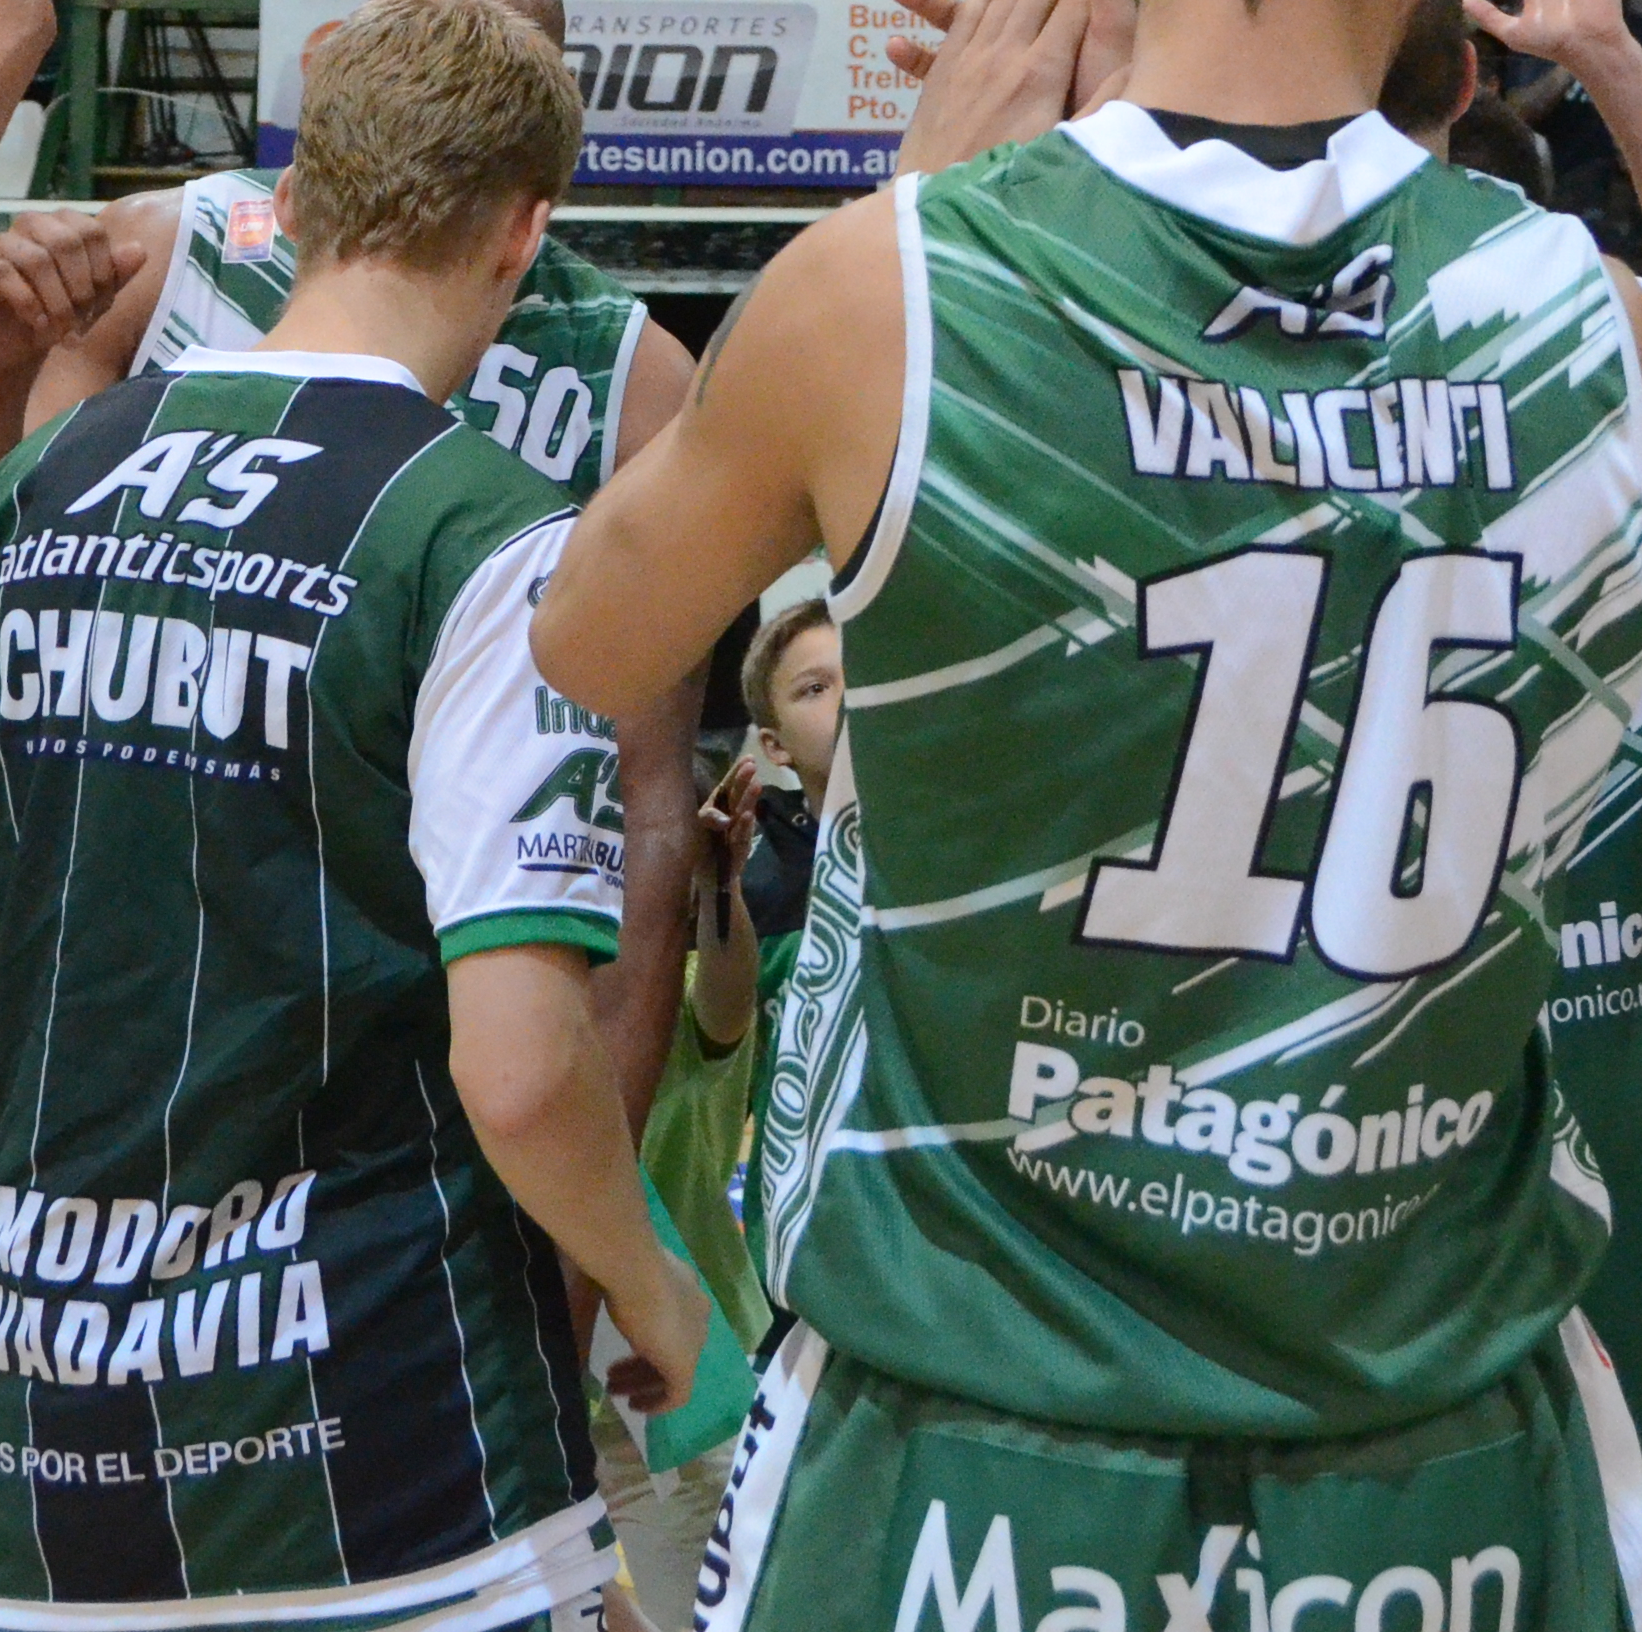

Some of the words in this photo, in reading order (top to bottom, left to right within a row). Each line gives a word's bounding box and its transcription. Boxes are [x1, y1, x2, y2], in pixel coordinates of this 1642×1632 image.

[469, 343, 593, 482] 50
[65, 431, 324, 530] A'S
[1072, 543, 1524, 982] 16
[1020, 994, 1146, 1049] Diario
[1008, 1040, 1494, 1187] Patagónico
[21, 1444, 87, 1485] POR
[95, 1451, 146, 1485] EL
[154, 1417, 346, 1480] DEPORTE
